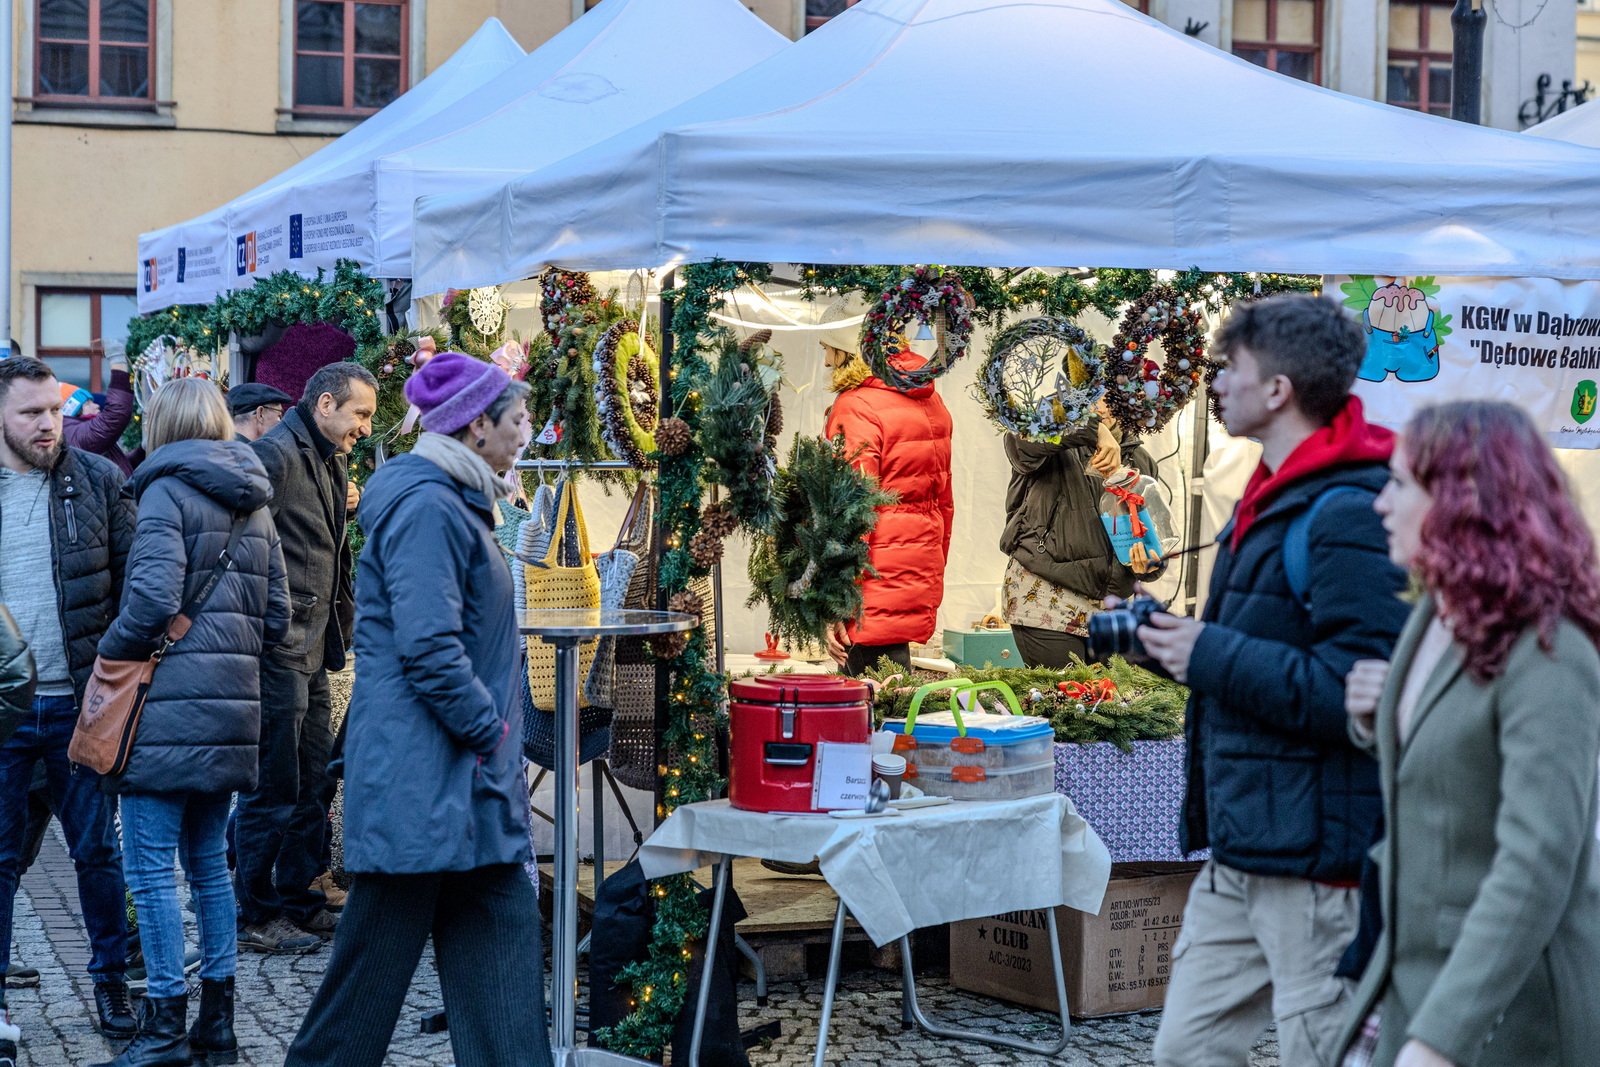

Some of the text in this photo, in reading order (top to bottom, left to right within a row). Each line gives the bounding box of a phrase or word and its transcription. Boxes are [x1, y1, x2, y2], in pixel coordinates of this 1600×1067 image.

[1461, 305, 1600, 340] KGW w Dąbrow
[1470, 339, 1558, 369] "Dębowe
[196, 574, 218, 605] LAURA
[1109, 909, 1148, 921] COLOR: NAVY
[1143, 918, 1150, 927] 41
[1152, 916, 1160, 926] 42
[1162, 915, 1170, 925] 43
[1171, 914, 1180, 923] 44
[993, 926, 1029, 950] CLUB
[1109, 948, 1122, 958] QTY:
[1157, 953, 1169, 964] KGS
[1157, 965, 1169, 975] KGS
